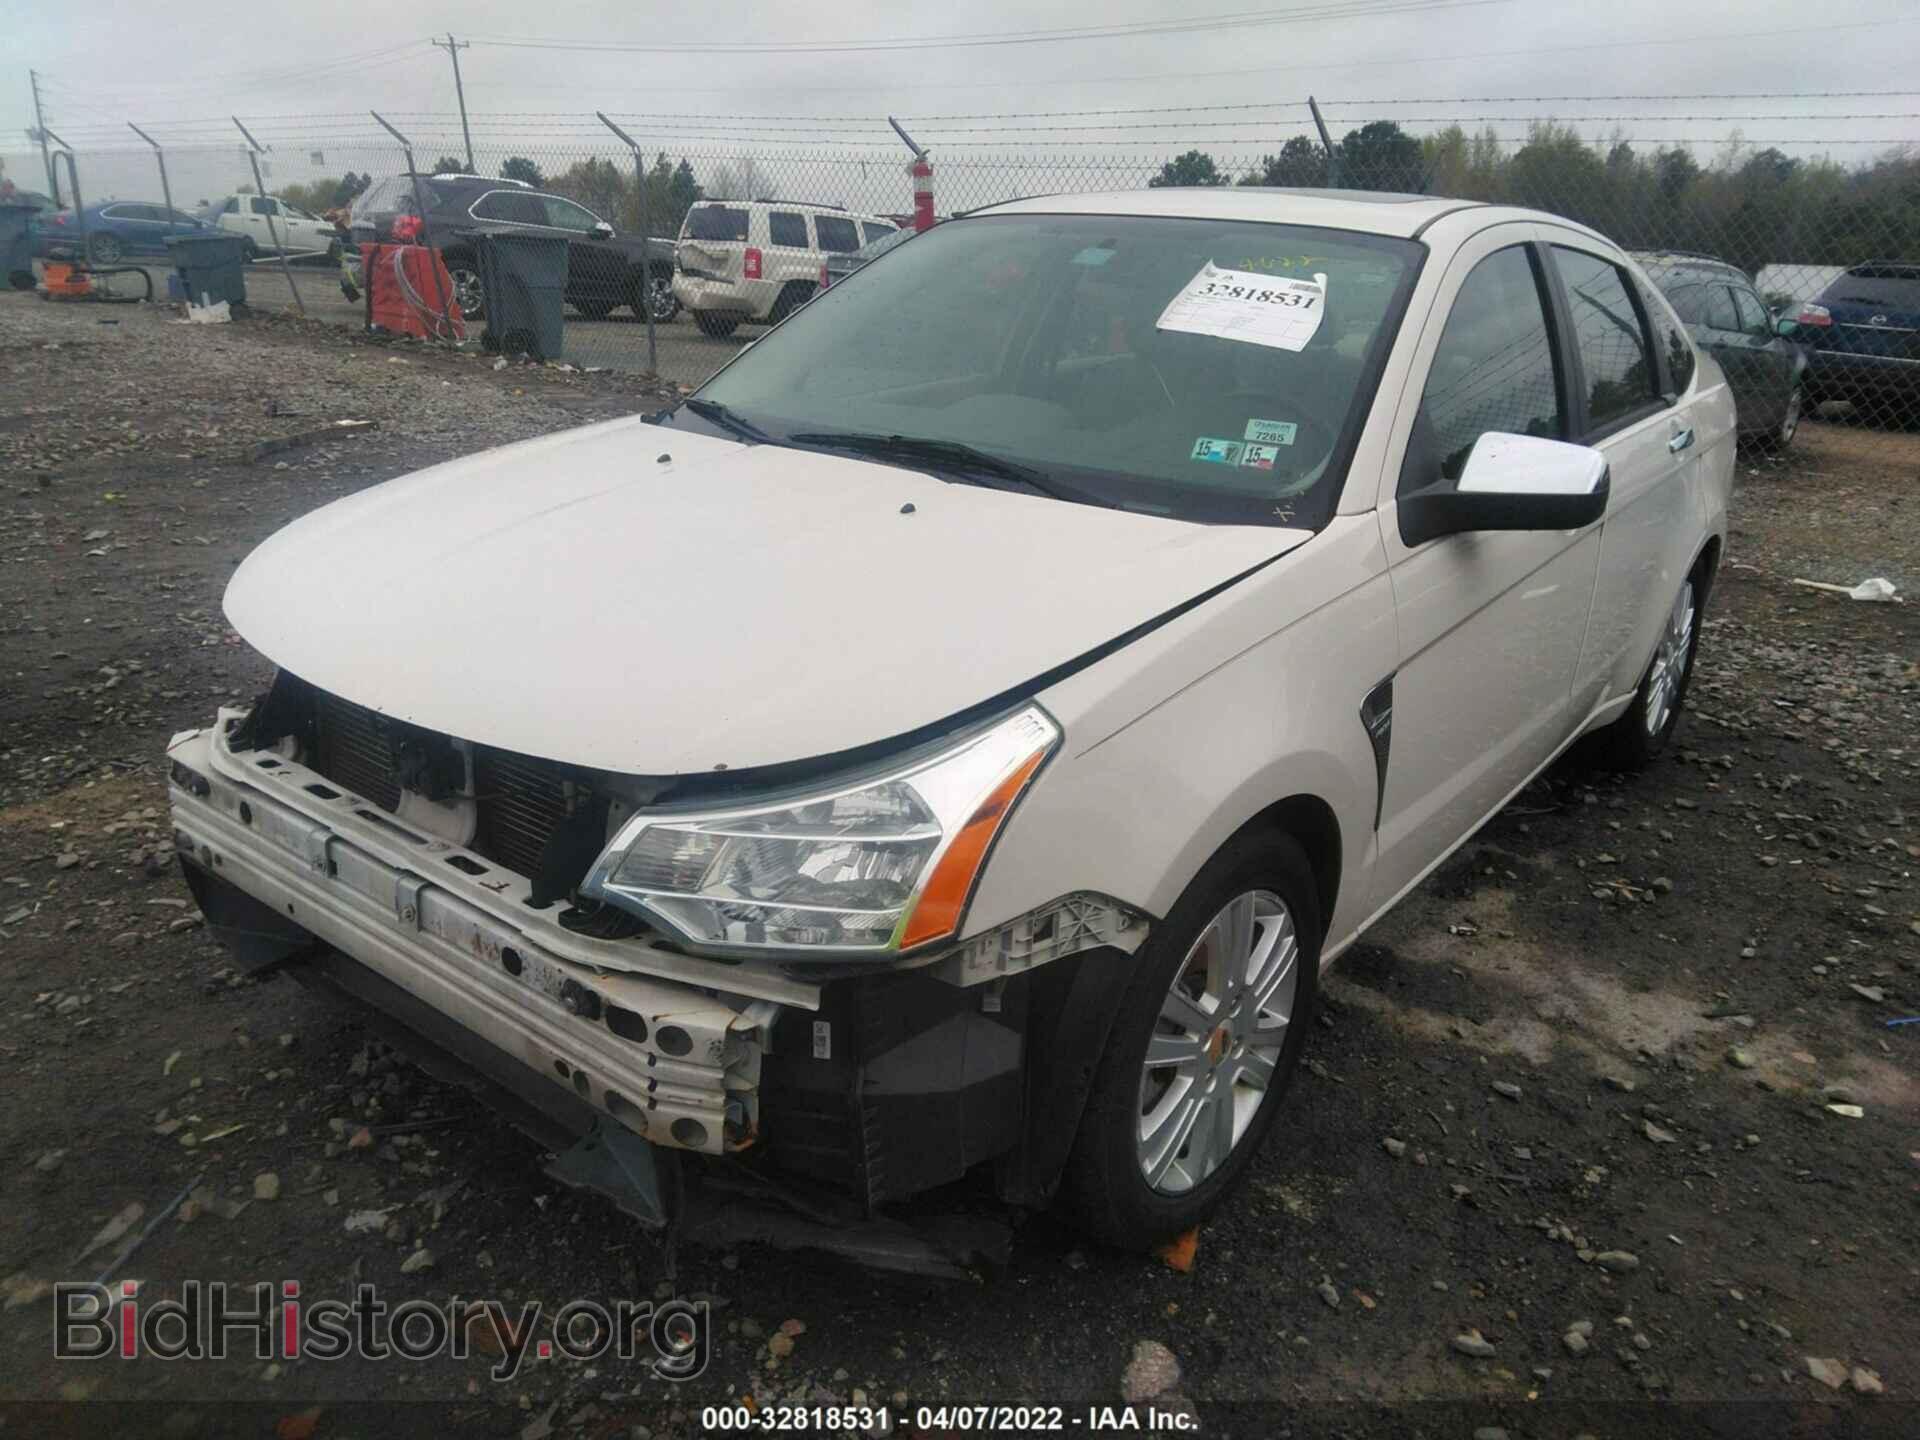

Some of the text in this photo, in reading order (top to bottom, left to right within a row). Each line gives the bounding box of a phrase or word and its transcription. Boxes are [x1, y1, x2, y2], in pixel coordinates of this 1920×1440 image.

[1199, 282, 1316, 310] 32818531
[1196, 439, 1213, 456] 15
[1245, 446, 1263, 464] 15
